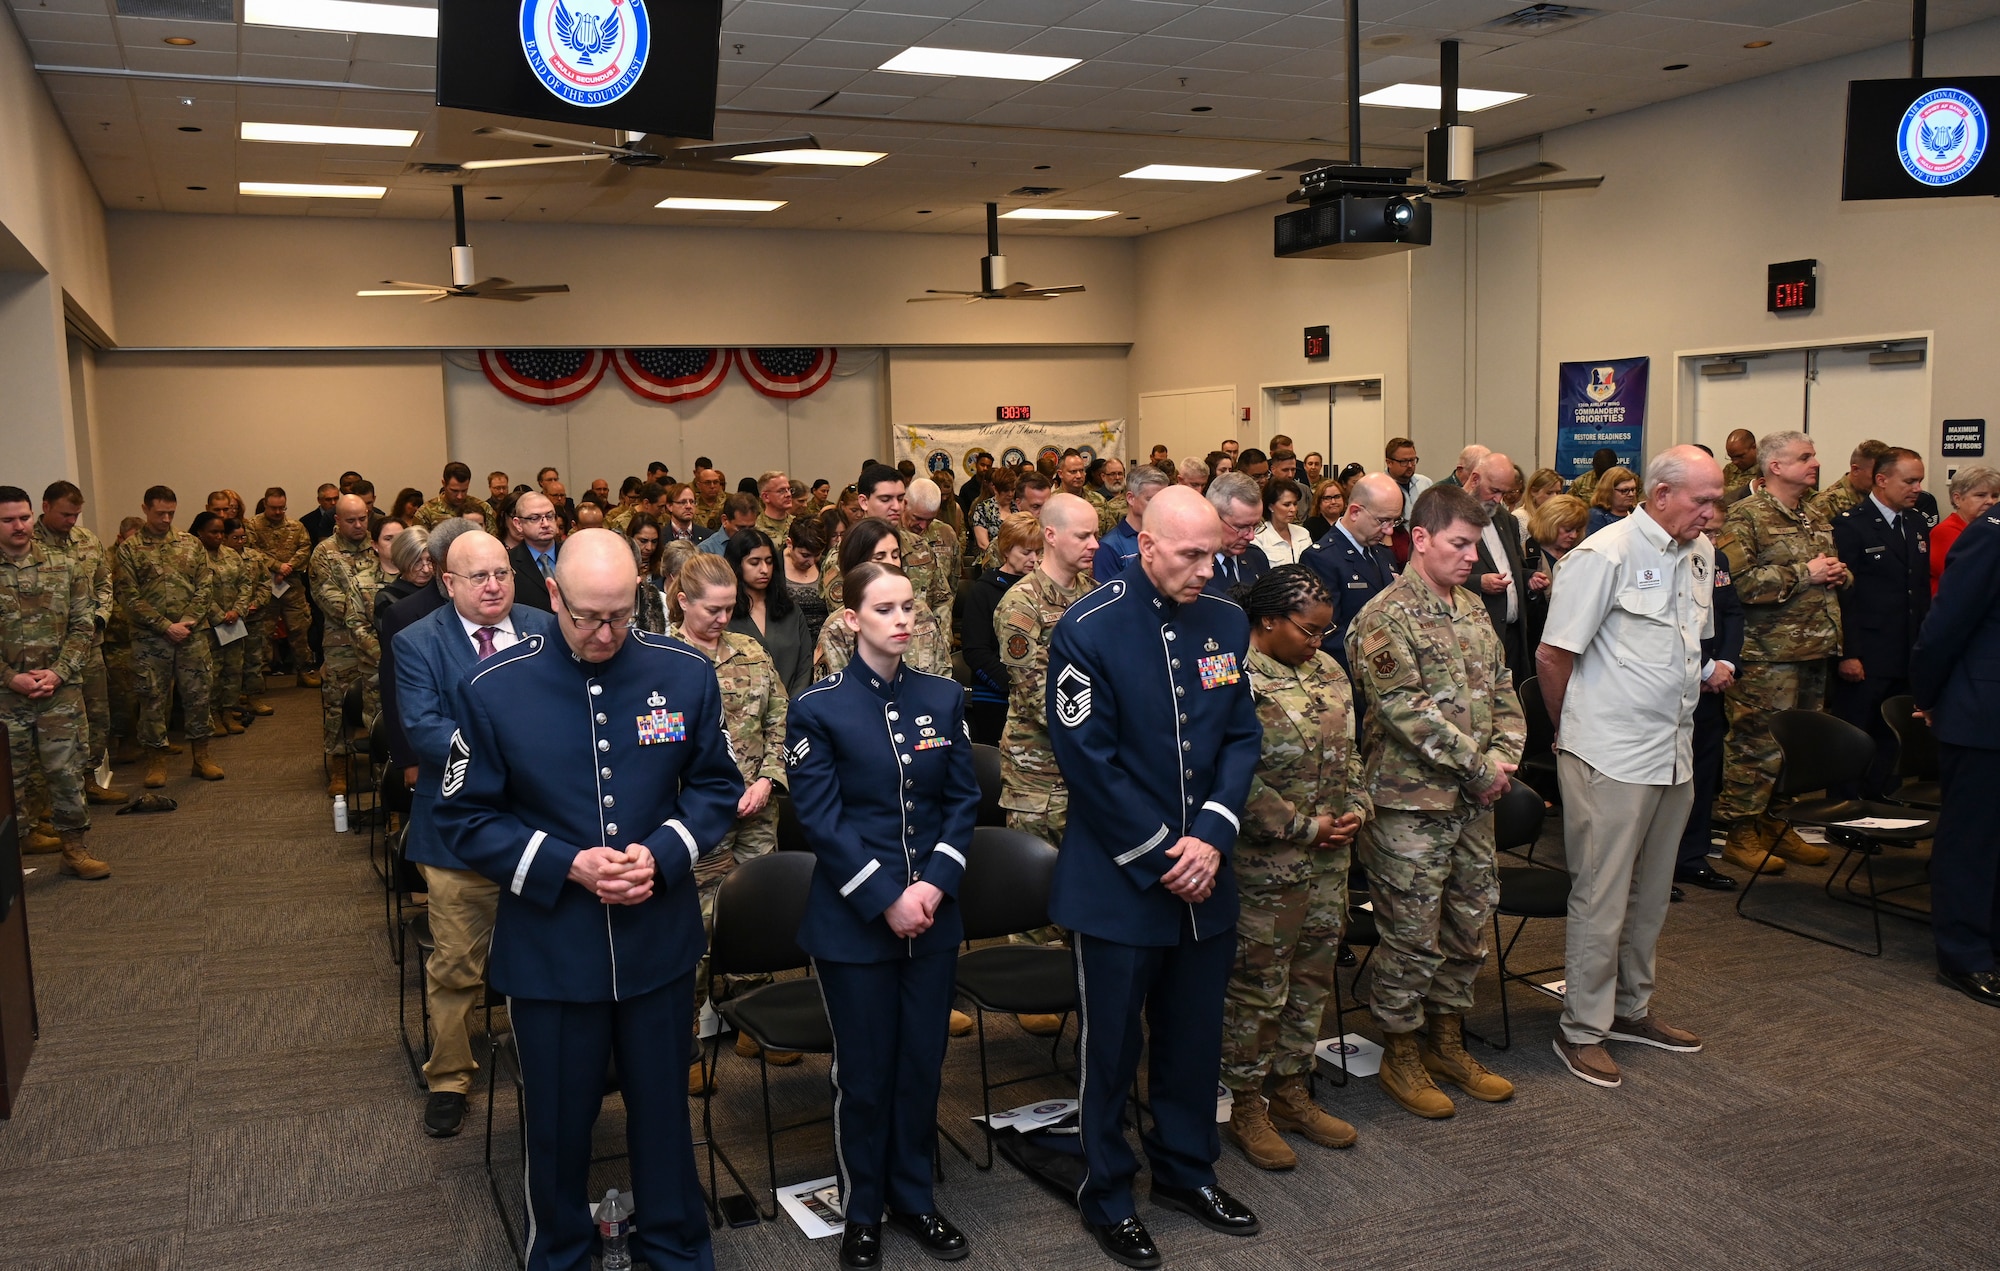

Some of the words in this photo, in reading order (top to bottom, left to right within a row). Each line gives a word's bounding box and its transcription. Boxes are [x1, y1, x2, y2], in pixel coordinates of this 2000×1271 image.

[526, 40, 548, 75] BAND
[546, 75, 562, 89] OF
[563, 86, 585, 102] THE
[587, 56, 642, 103] SOUTHWEST
[556, 61, 574, 78] NULLI
[576, 70, 613, 84] SECUNDUS
[1907, 105, 1920, 119] AIR
[1918, 91, 1958, 106] NATIONAL
[1958, 94, 1981, 117] GUARD
[1901, 149, 1915, 170] BAND
[1914, 167, 1924, 178] OF
[1925, 174, 1940, 183] THE
[1941, 148, 1981, 183] SOUTHWEST
[1776, 281, 1805, 307] EXIT
[1001, 406, 1020, 419] 1303
[1574, 407, 1626, 415] COMMANDER'S
[1575, 414, 1624, 423] PRIORITIES
[978, 425, 1002, 435] Wall
[1016, 424, 1047, 435] Thanks
[1597, 432, 1631, 440] READINESS
